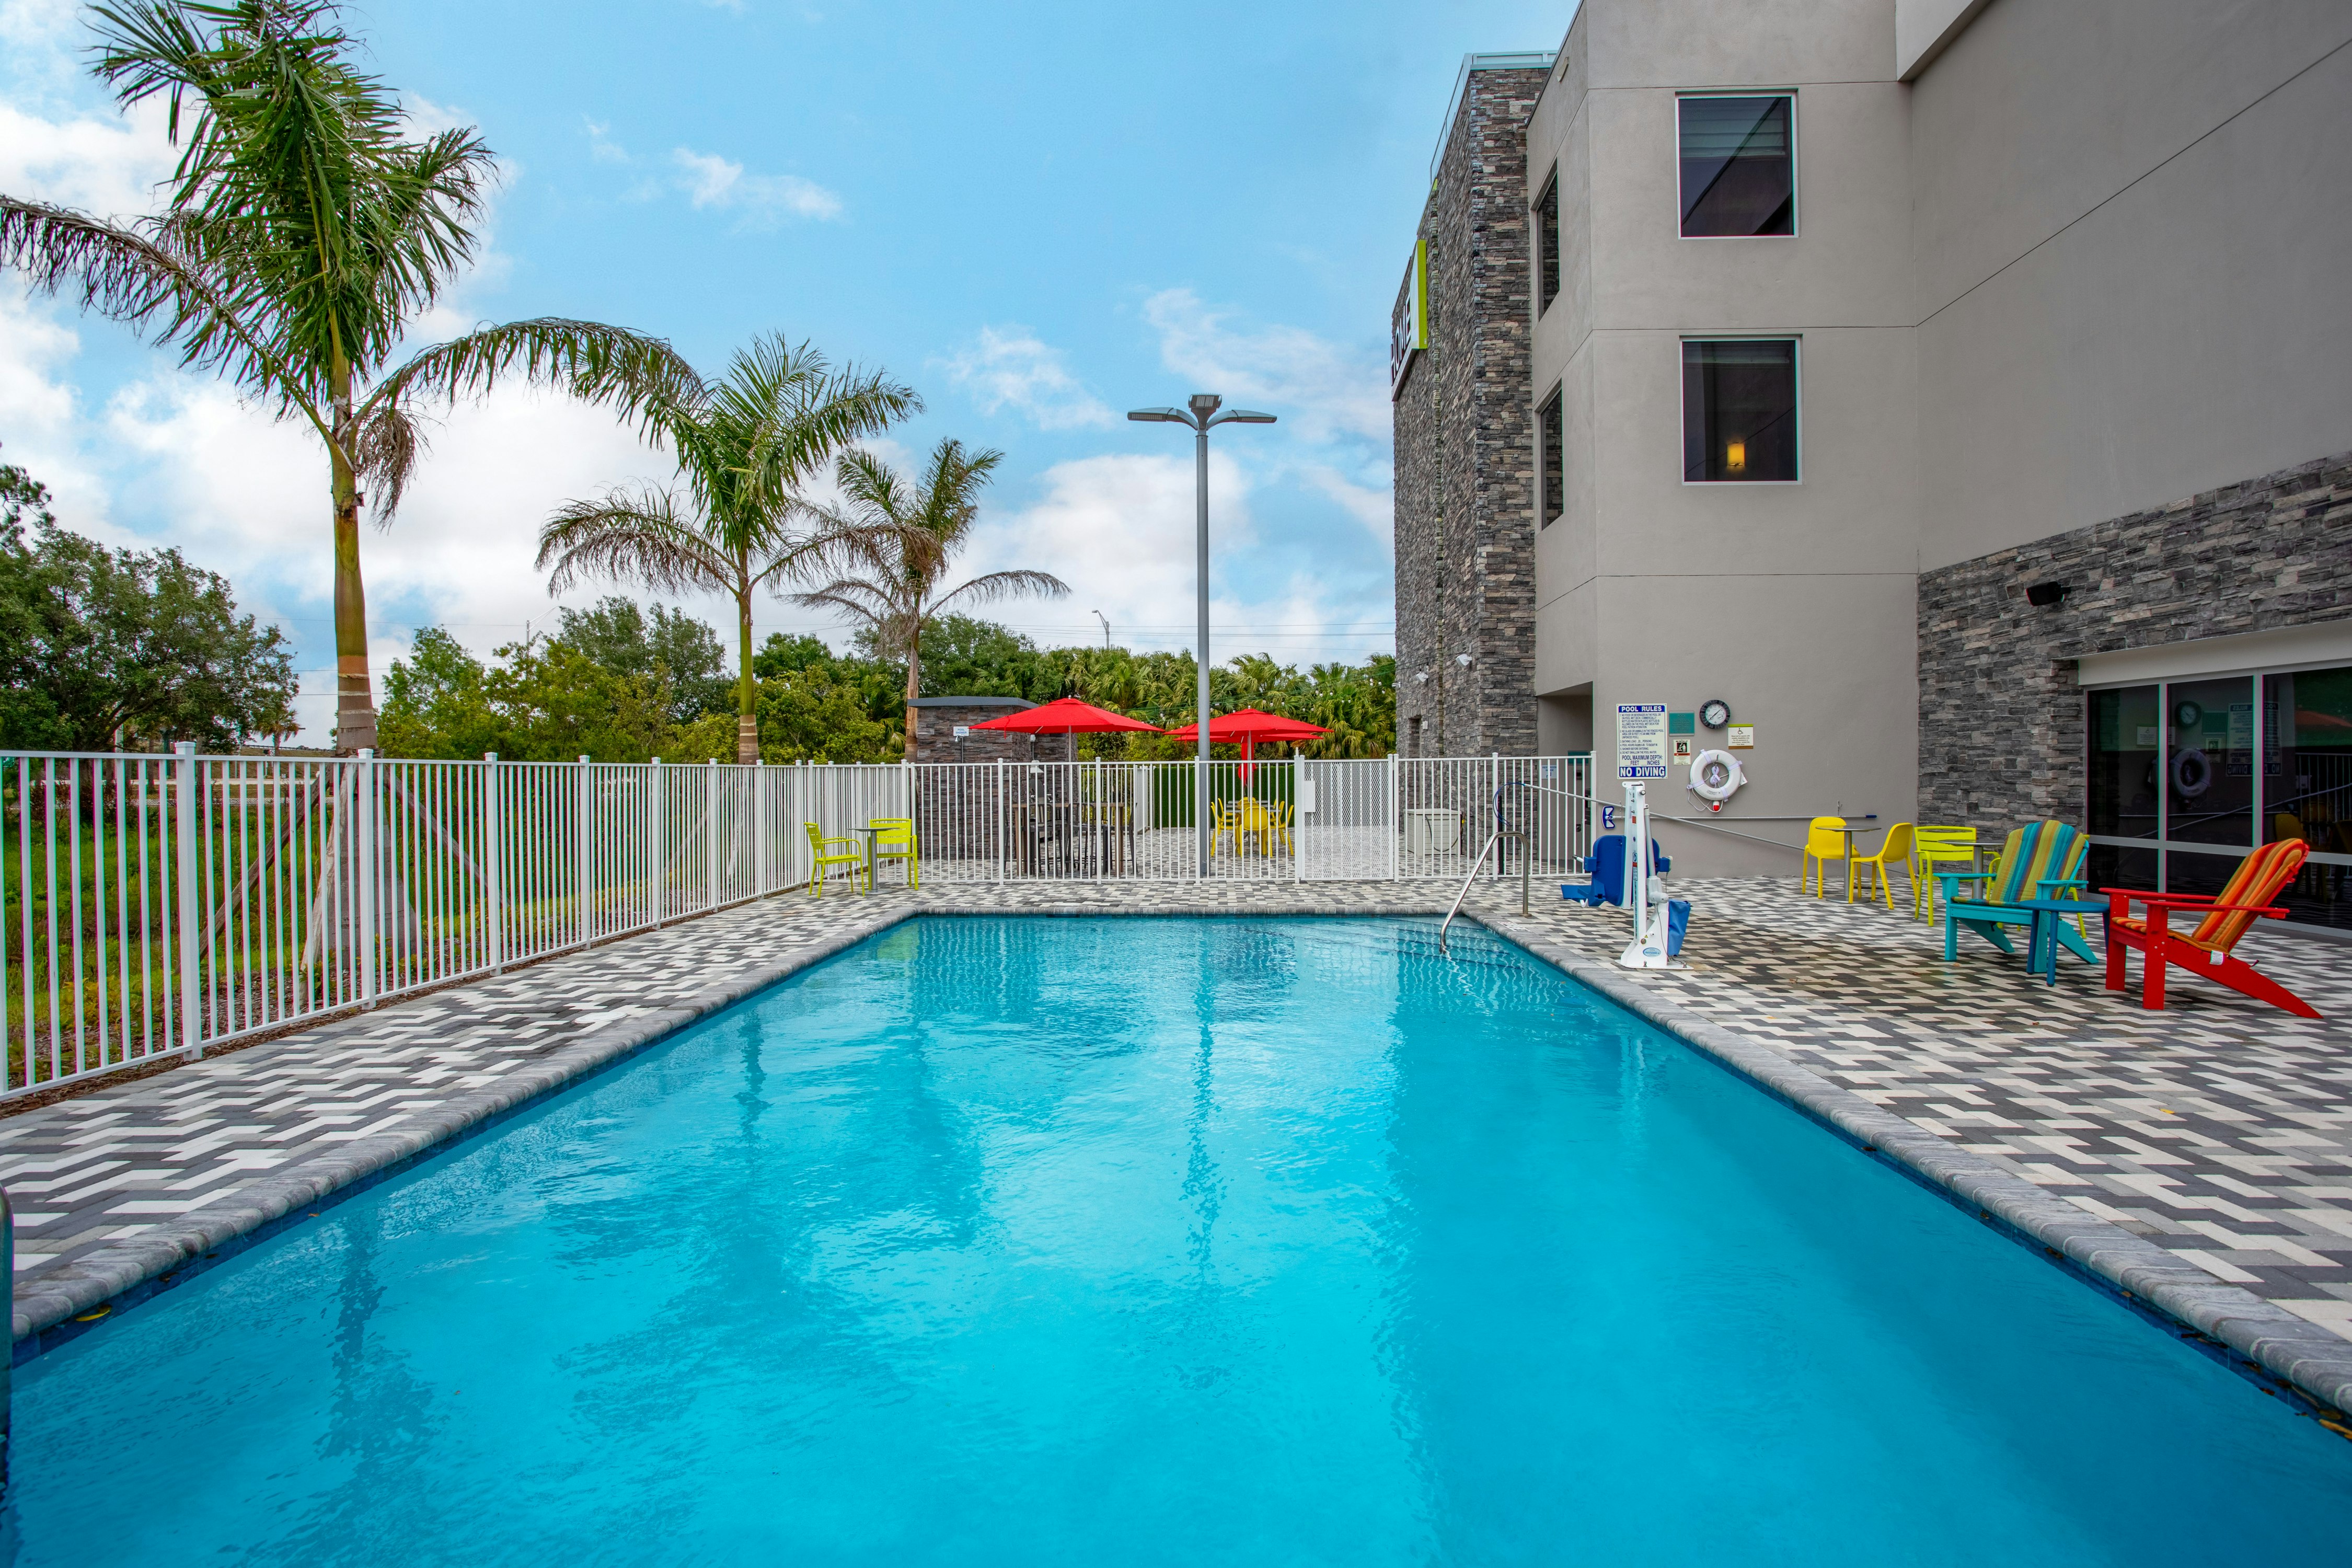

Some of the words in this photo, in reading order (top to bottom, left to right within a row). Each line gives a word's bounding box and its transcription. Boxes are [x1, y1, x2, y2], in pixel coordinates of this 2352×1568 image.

[1390, 292, 1411, 387] HOME
[1620, 767, 1632, 776] NO
[1636, 767, 1665, 776] DIVING
